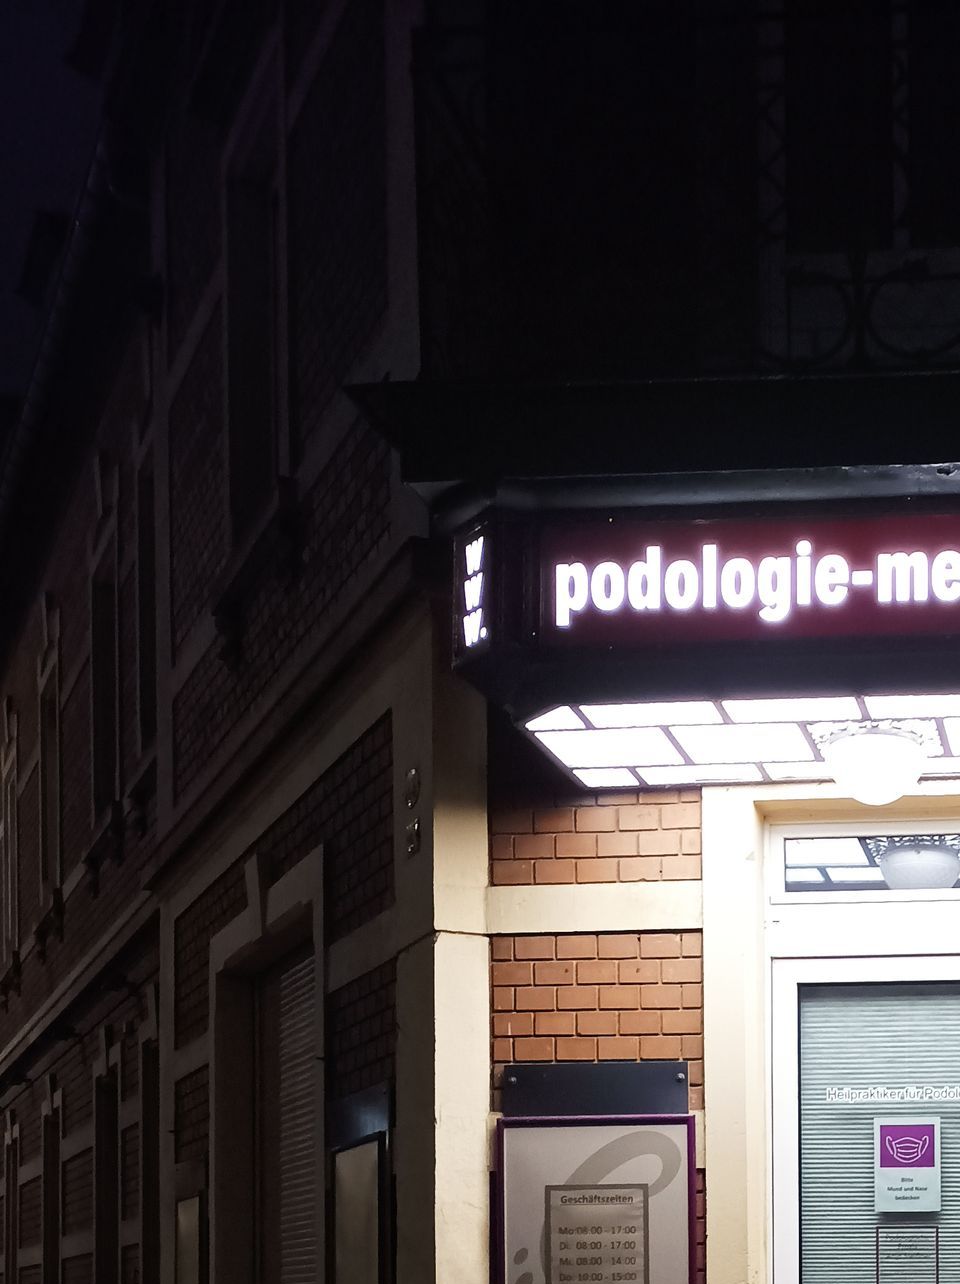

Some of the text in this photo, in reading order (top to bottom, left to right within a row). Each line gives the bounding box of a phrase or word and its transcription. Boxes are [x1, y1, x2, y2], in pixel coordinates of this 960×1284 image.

[463, 536, 487, 647] www.
[827, 1088, 900, 1102] Heilpraktiker
[560, 1194, 634, 1206] Geschäftszeiten
[611, 1226, 637, 1235] 17:00
[575, 1241, 602, 1250] 08:00
[610, 1241, 636, 1250] 17:00
